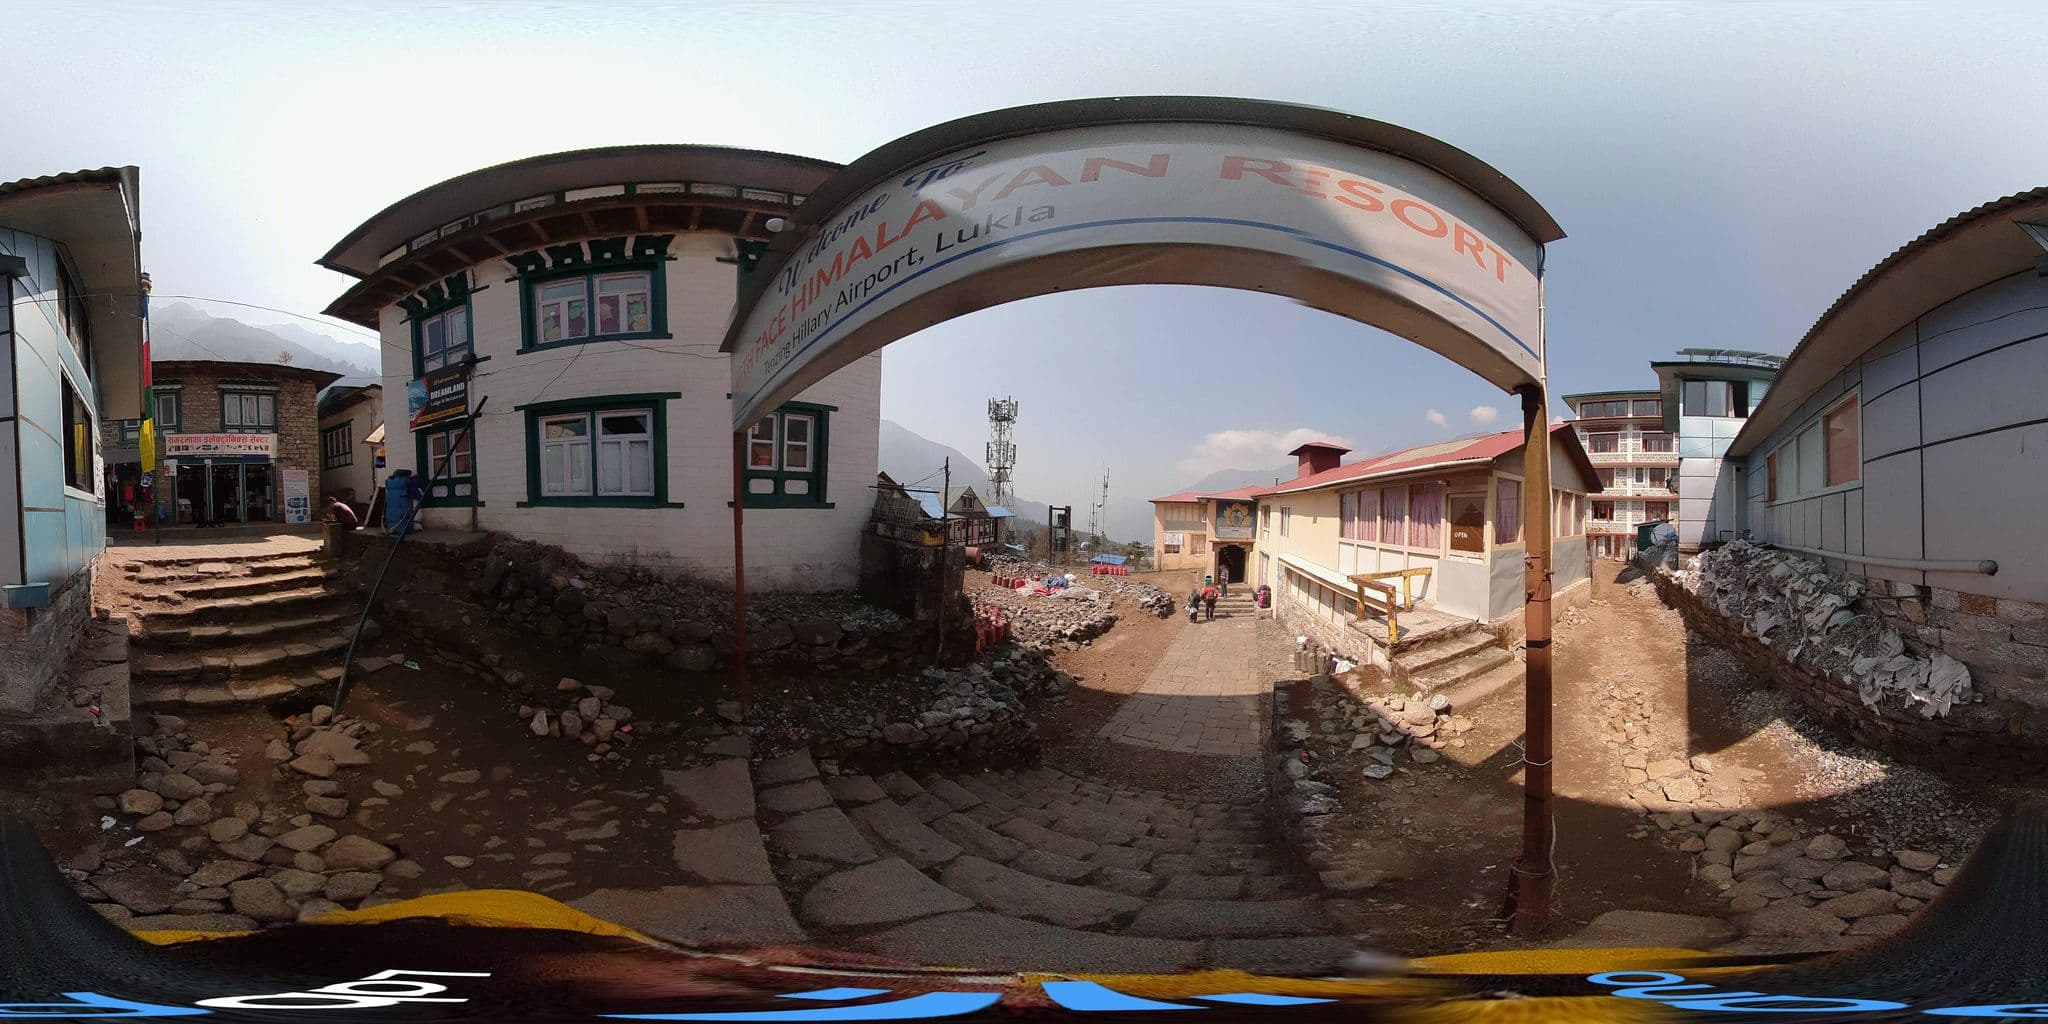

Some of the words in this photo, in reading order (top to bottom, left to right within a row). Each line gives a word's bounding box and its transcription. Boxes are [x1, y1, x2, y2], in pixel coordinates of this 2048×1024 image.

[756, 304, 788, 362] FACE
[792, 154, 1171, 322] HIMALAYAN
[1219, 155, 1513, 285] RESORT
[764, 341, 792, 375] Tenzing
[793, 303, 833, 348] Hillary
[835, 247, 925, 307] Airport,
[936, 203, 1055, 253] Lukla
[778, 191, 889, 297] Welcome
[903, 150, 987, 199] To
[430, 382, 465, 400] DREAMLAND
